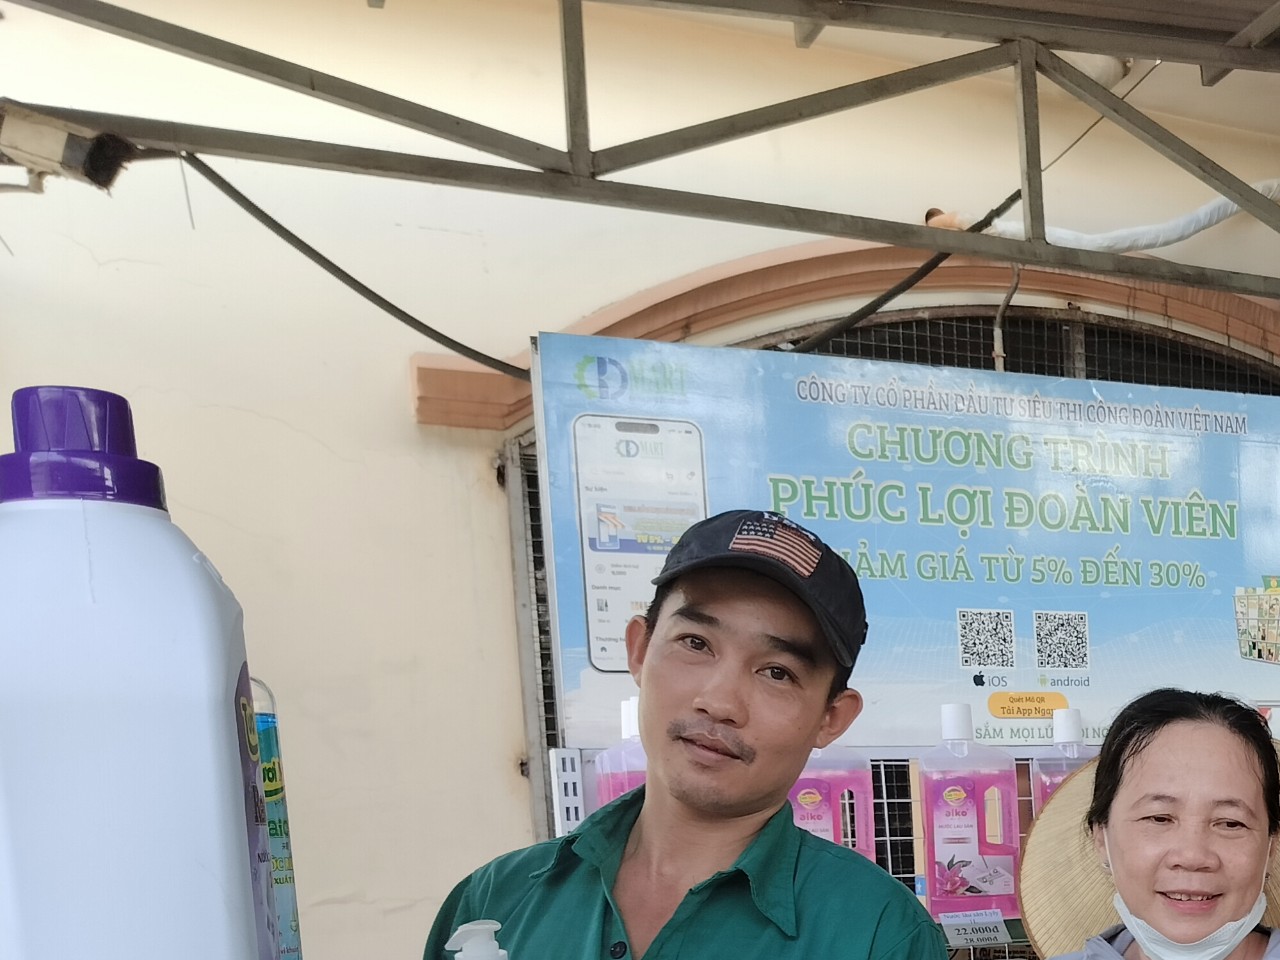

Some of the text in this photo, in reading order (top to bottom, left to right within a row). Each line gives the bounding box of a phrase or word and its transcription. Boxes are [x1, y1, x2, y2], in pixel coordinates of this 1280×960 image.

[797, 375, 847, 403] CÔNG
[851, 384, 872, 406] TY
[876, 377, 898, 408] CỔ
[902, 378, 950, 412] PHẦN
[1018, 394, 1053, 420] SIÊU
[1055, 401, 1084, 428] THỊ
[1086, 400, 1129, 426] CÔNG
[1132, 404, 1175, 430] ĐOÀN
[1178, 406, 1211, 438] VIỆT
[1213, 414, 1248, 435] NAM
[847, 420, 1170, 479] CHƯƠNG TRÌNH
[768, 469, 1239, 539] PHÚC LỢI ĐOÀN VIÊN
[844, 541, 1206, 589] IẢM GIÁ TỪ 5% ĐẾN 30%
[987, 675, 1008, 688] iOS
[1050, 675, 1091, 688] android
[1036, 696, 1046, 704] QR
[1000, 706, 1015, 715] Tải
[1016, 706, 1033, 717] App
[975, 722, 1053, 742] SẮM MỌI LÚ
